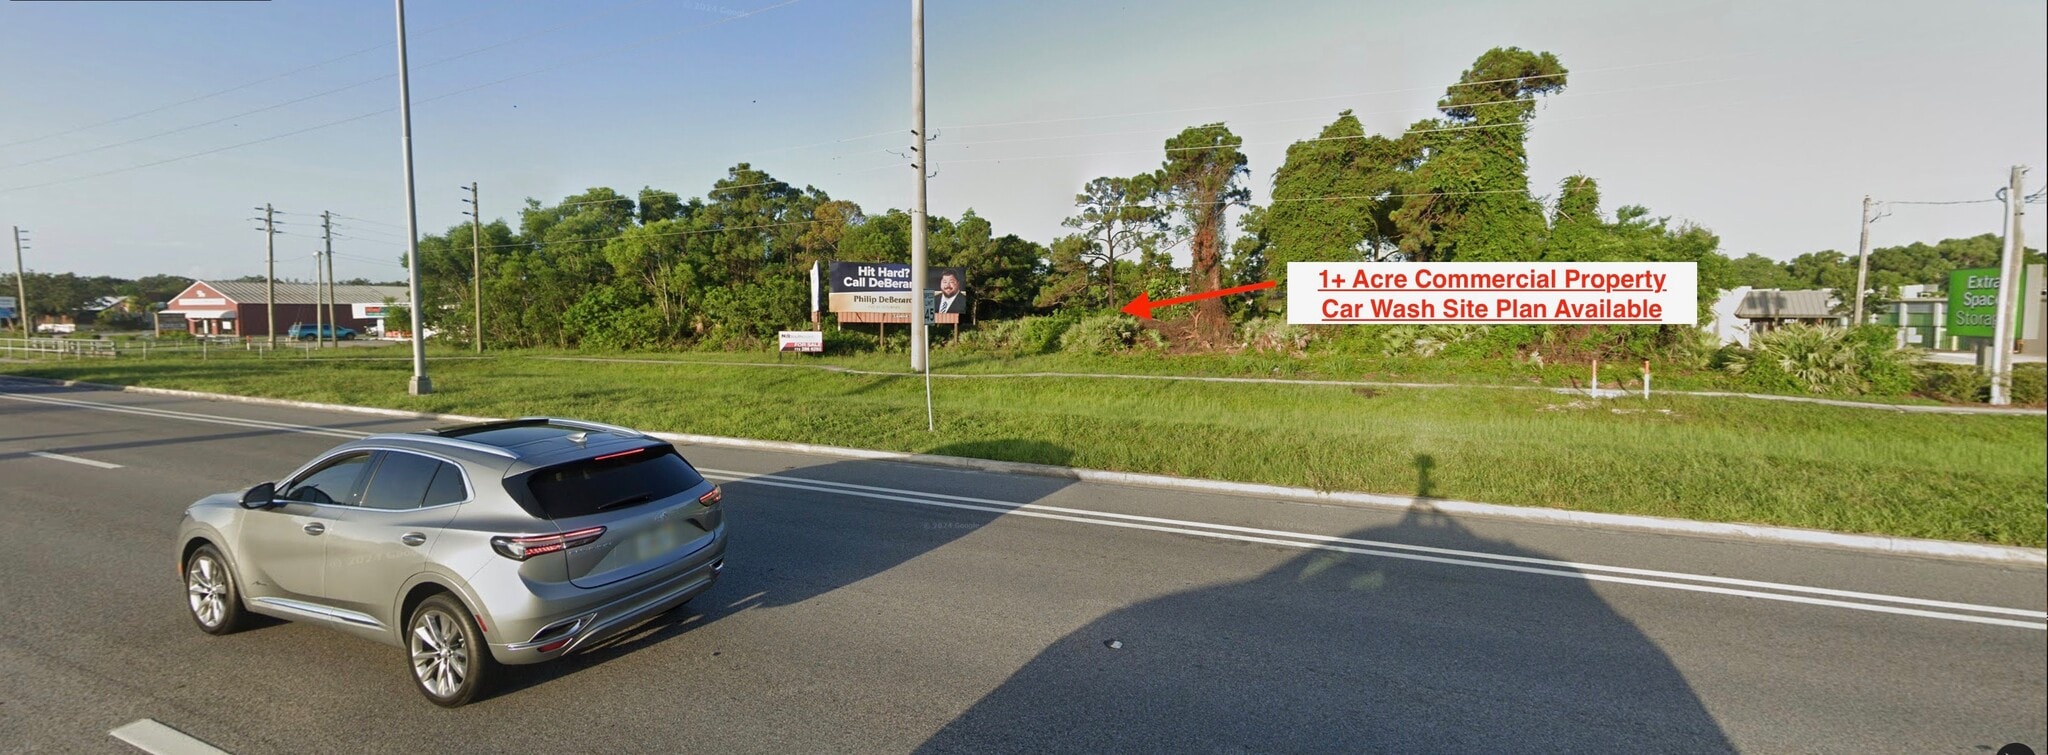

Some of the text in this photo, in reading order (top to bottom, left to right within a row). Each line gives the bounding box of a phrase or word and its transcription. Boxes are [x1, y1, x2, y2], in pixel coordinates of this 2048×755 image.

[858, 265, 911, 278] Hit Hard?
[843, 276, 912, 289] Call DeBerar
[1968, 275, 2001, 289] Extra
[853, 295, 877, 305] Philip
[924, 307, 935, 322] 45
[1956, 311, 1997, 328] Storag
